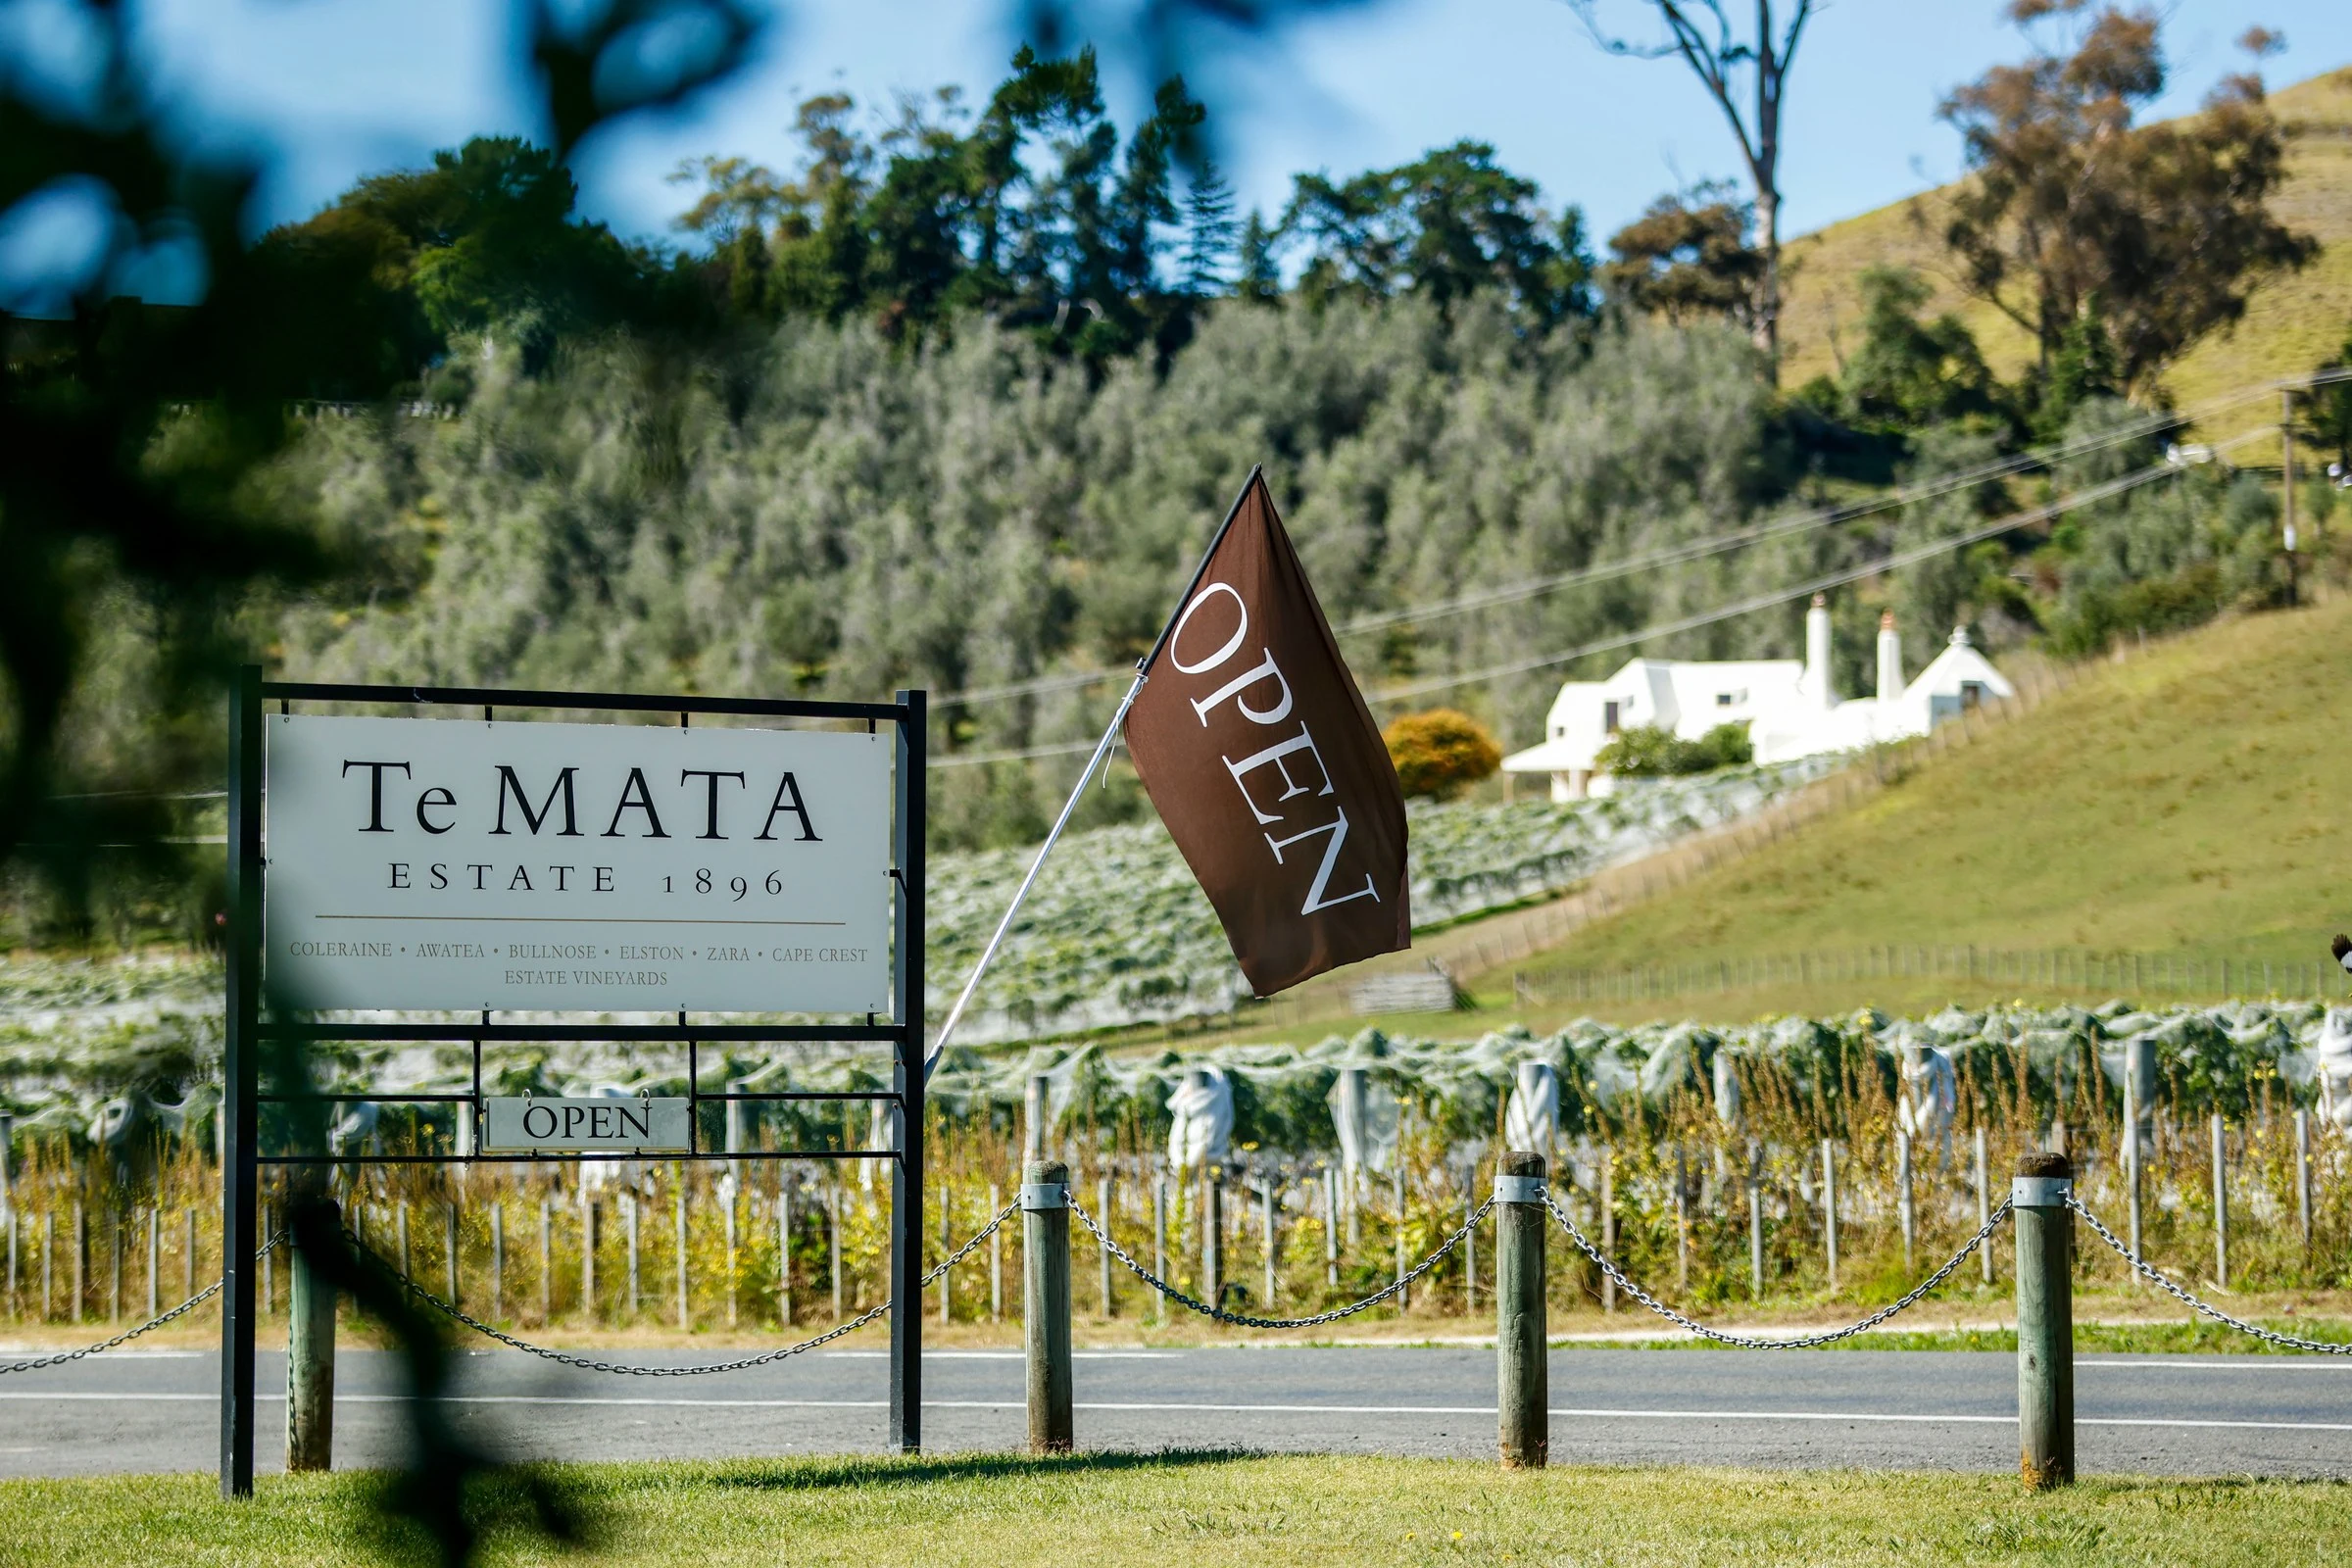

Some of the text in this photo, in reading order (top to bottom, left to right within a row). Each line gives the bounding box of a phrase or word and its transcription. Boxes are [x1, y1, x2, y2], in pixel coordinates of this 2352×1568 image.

[1170, 581, 1381, 916] OPEN
[341, 759, 824, 842] Te MATA
[387, 862, 783, 903] ESTATE 1896
[289, 941, 868, 962] COLERAINE AWATEA BULLNOSE ELSTON ZARA CAPE CREST
[505, 969, 667, 986] ESTATE VINEYARDS
[522, 1104, 654, 1140] OPEN
